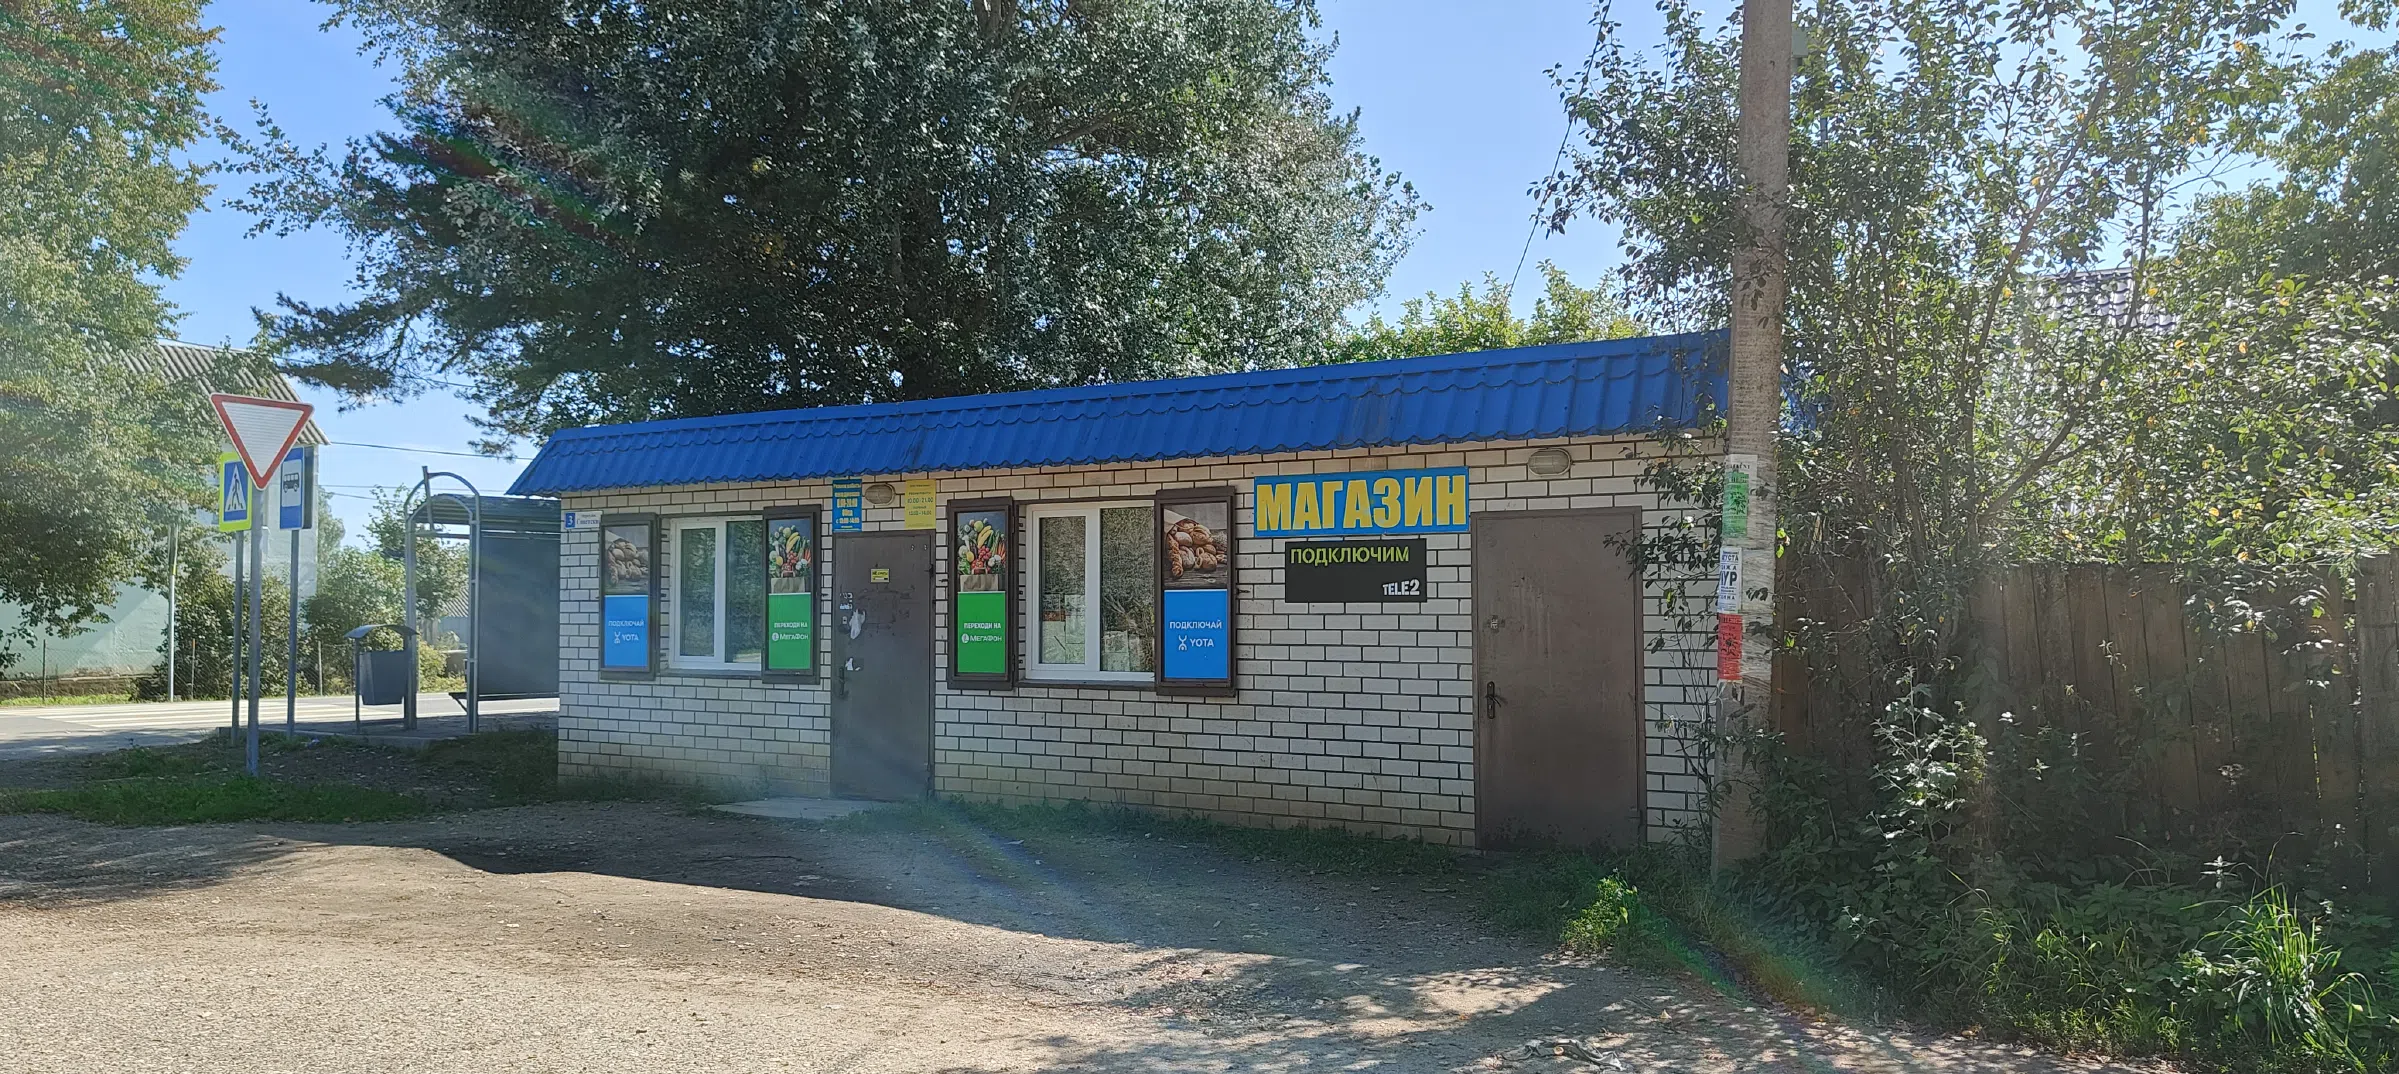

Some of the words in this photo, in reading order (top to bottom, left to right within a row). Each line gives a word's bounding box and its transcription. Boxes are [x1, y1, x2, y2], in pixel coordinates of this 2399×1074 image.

[1256, 475, 1467, 531] МАГАЗИН
[567, 515, 574, 525] 3
[1290, 546, 1409, 567] ПОДКЛЮЧИМ
[1382, 579, 1420, 596] TELE2
[608, 619, 645, 627] ПОДКЛЮЧАЙ
[963, 622, 993, 630] ПЕРЕХОДИ
[1169, 619, 1222, 630] ПОДКЛЮЧАЙ
[621, 633, 640, 641] YOTA
[1189, 638, 1215, 648] YOTA
